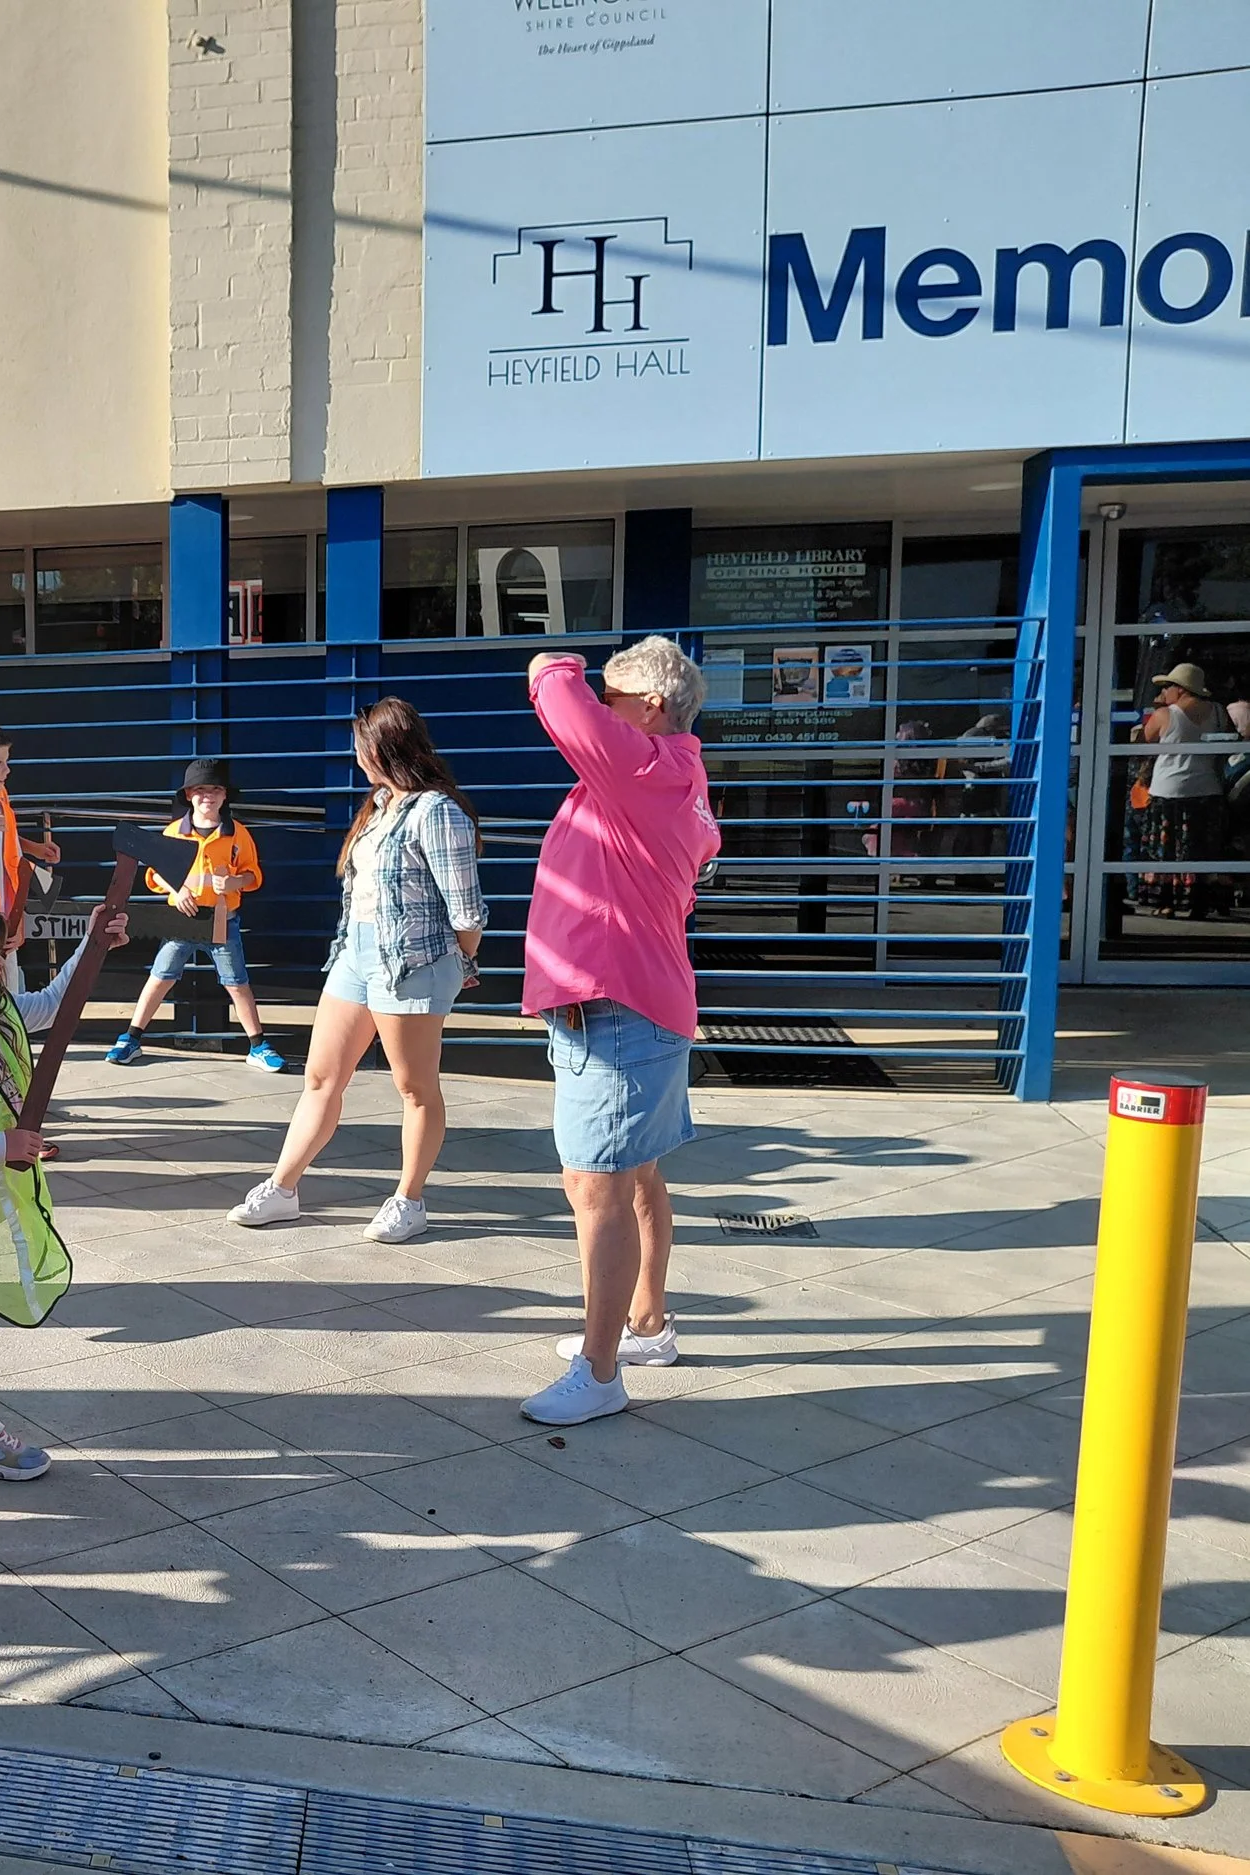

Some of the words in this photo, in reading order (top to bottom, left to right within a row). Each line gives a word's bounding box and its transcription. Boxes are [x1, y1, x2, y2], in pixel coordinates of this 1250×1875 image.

[525, 16, 574, 33] SHIRE
[585, 8, 667, 27] COUNCIL
[557, 43, 587, 54] Heart
[589, 40, 599, 54] of
[602, 34, 656, 52] Gippsland
[766, 226, 1250, 346] Memo
[488, 355, 601, 387] HEYFIELD
[616, 348, 691, 378] HALL
[707, 550, 789, 565] HEYFIELD
[796, 549, 866, 563] LIBRARY
[713, 567, 790, 578] OPENING
[799, 564, 858, 574] HOURS
[721, 733, 761, 742] WENDY
[1119, 1102, 1160, 1114] BARRIER
